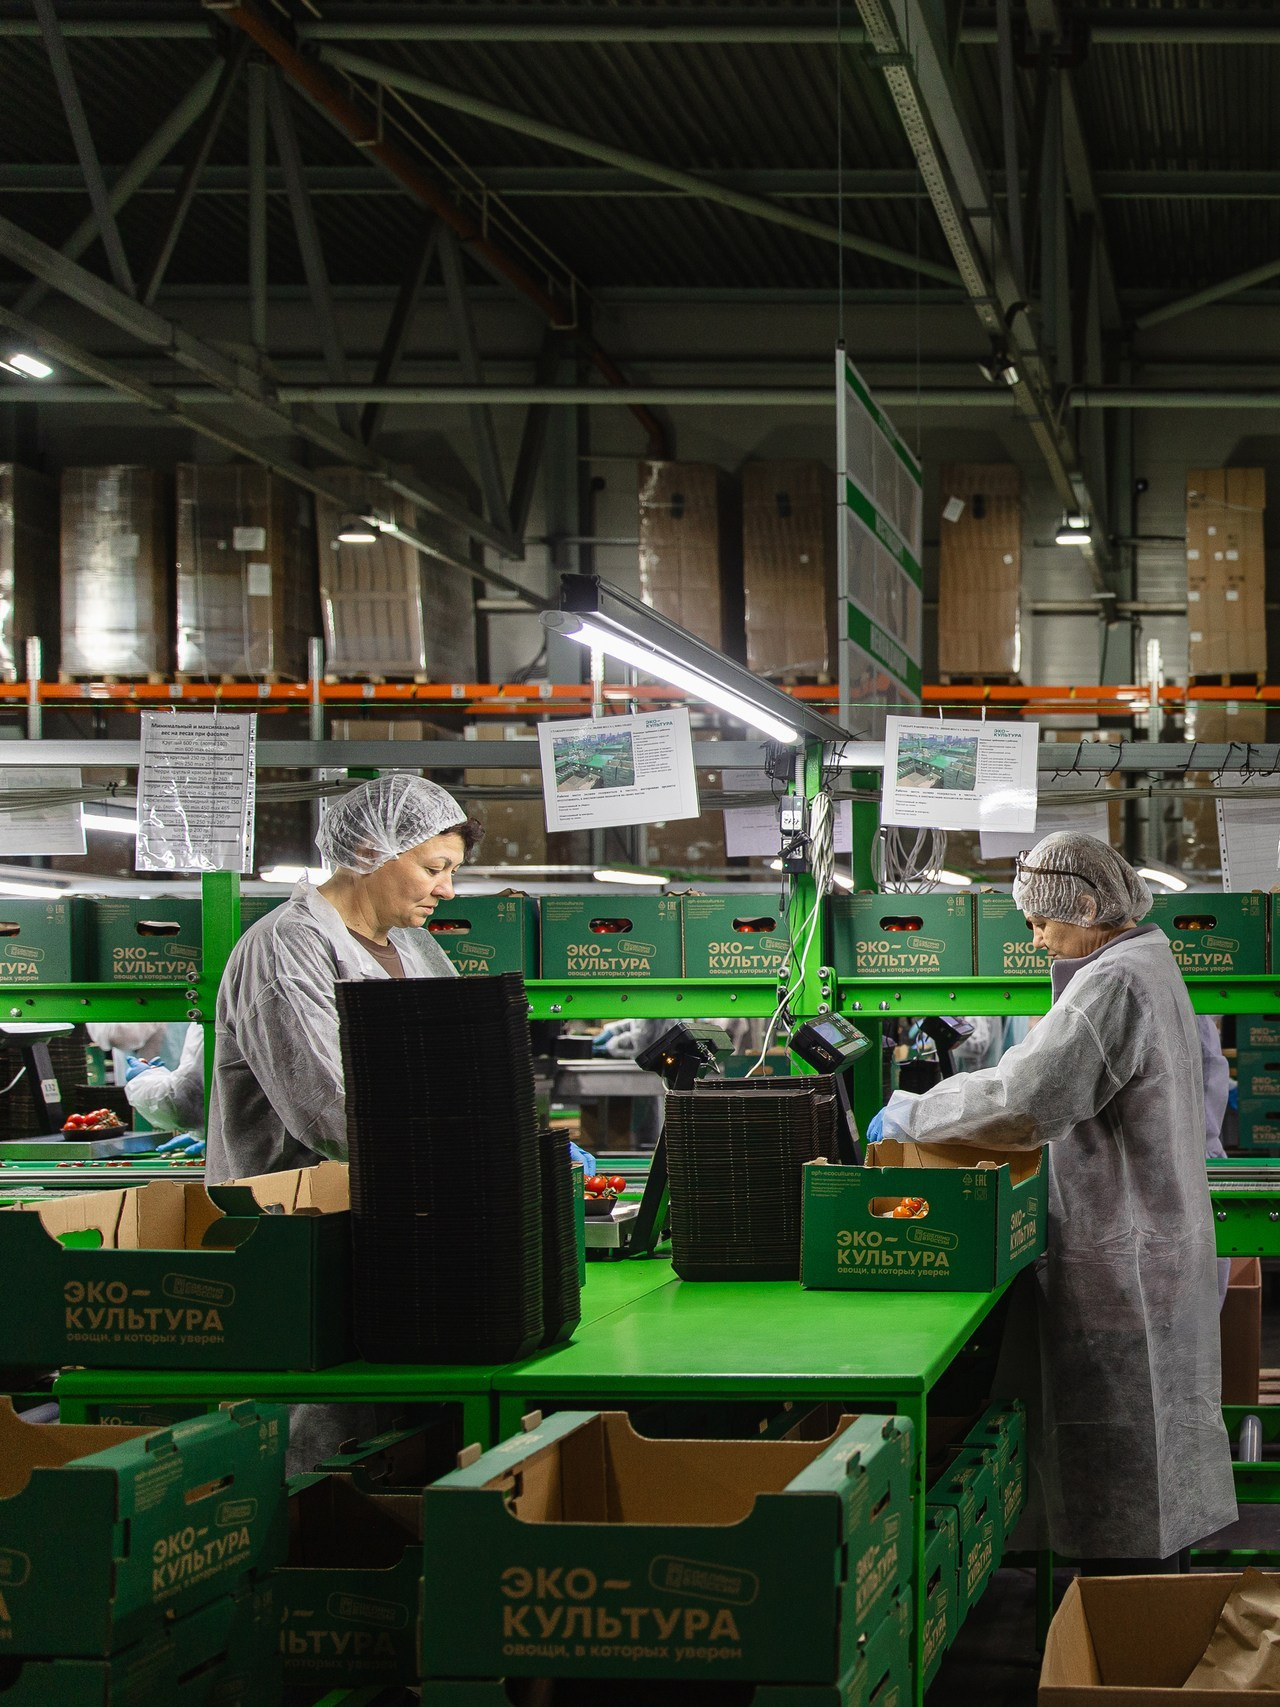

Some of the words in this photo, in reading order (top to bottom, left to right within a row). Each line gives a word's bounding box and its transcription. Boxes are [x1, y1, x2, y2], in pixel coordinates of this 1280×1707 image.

[1003, 942, 1037, 954] ЭКО
[568, 958, 650, 970] КУЛЬТУРА
[709, 956, 790, 968] КУЛЬТУР
[856, 954, 940, 966] КУЛЬТУРА
[1004, 956, 1053, 968] КУЛЬТ
[1174, 954, 1233, 965] ЛЬТУРА
[0, 962, 39, 974] ТУРА
[114, 962, 197, 973] КУЛЬТУРА
[837, 1249, 949, 1267] КУЛЬТУРА
[838, 1267, 869, 1275] овощи,
[878, 1268, 915, 1276] которых
[65, 1308, 224, 1331] КУЛЬТУРА
[66, 1334, 111, 1343] овощи,
[125, 1334, 176, 1344] которых
[181, 1334, 224, 1345] уверен
[153, 1527, 250, 1592] КУЛЬТУРА
[503, 1605, 741, 1641] КУЛЬТУРА
[280, 1630, 396, 1654] ЬТУРА
[503, 1644, 570, 1658] овощи,
[576, 1645, 585, 1656] в
[590, 1645, 669, 1662] которых
[674, 1646, 742, 1663] уверен
